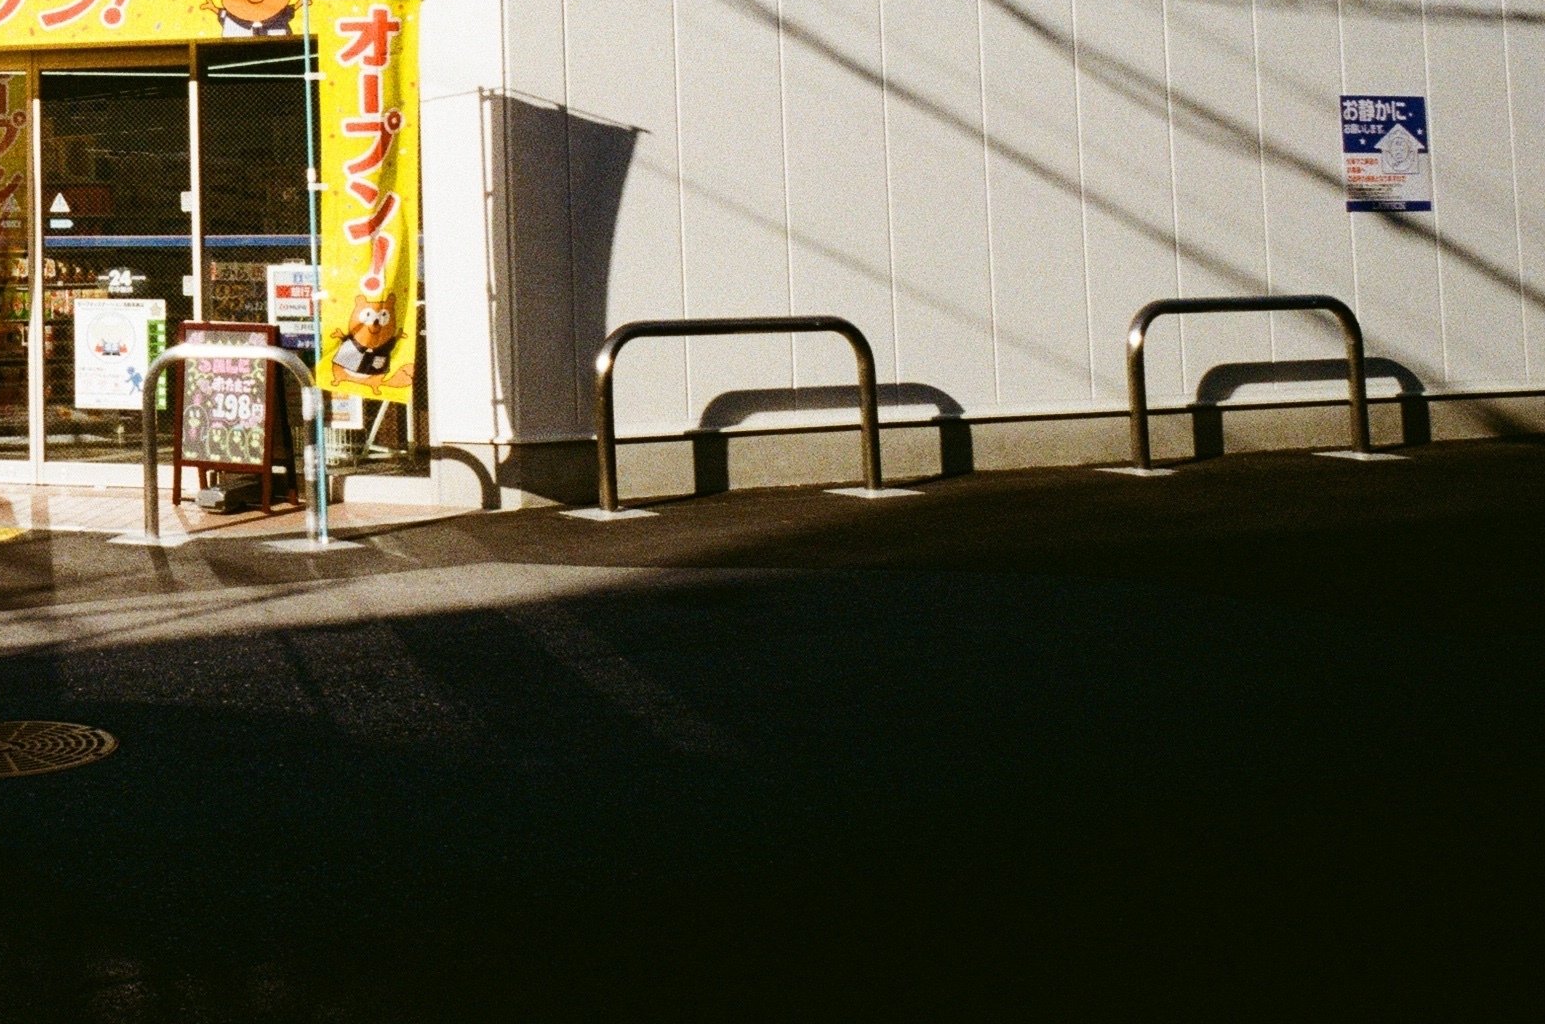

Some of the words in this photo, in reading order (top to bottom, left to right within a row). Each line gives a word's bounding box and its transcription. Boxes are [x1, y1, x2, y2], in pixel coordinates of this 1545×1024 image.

[1342, 99, 1406, 122] お静かに
[339, 8, 402, 289] オープン!
[108, 269, 132, 286] 24
